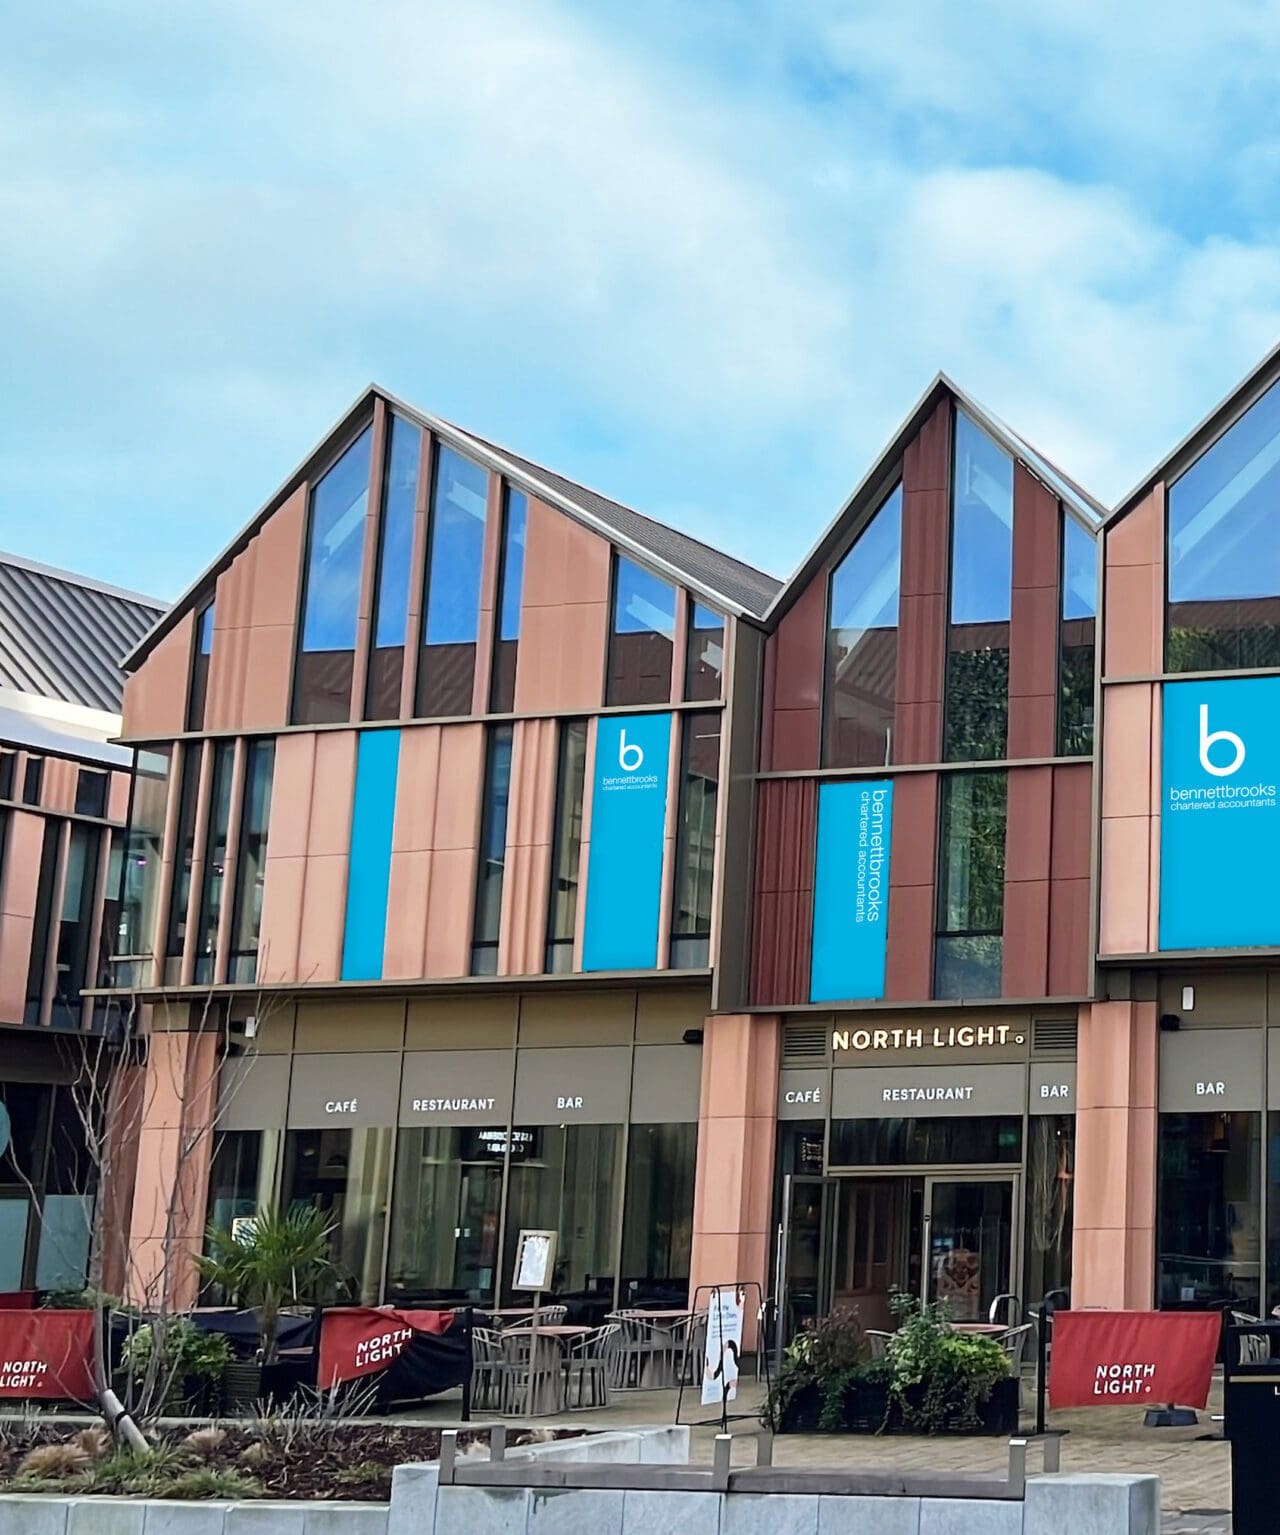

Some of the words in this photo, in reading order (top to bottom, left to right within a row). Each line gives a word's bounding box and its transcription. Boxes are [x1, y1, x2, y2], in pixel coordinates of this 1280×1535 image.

[1199, 703, 1246, 777] b
[619, 728, 644, 772] b
[602, 774, 659, 786] bennettbrooks
[1170, 782, 1277, 801] bennettbrooks
[1170, 800, 1216, 811] chartered
[1217, 798, 1277, 809] accountants
[858, 791, 871, 848] chartered
[867, 790, 888, 922] bennettbrooks
[855, 850, 867, 923] accountants
[832, 1028, 923, 1051] NORTH
[785, 1087, 822, 1103] CAFÉ
[882, 1086, 974, 1102] RESTAURANT
[1040, 1084, 1070, 1098] BAR
[1195, 1082, 1226, 1096] BAR
[325, 1098, 358, 1113] CAFÉ
[412, 1098, 496, 1112] RESTAURANT
[557, 1096, 584, 1110] BAR
[357, 1327, 413, 1354] NORTH
[355, 1342, 403, 1368] LIGHT
[2, 1360, 48, 1374] NORTH
[1095, 1363, 1156, 1379] NORTH
